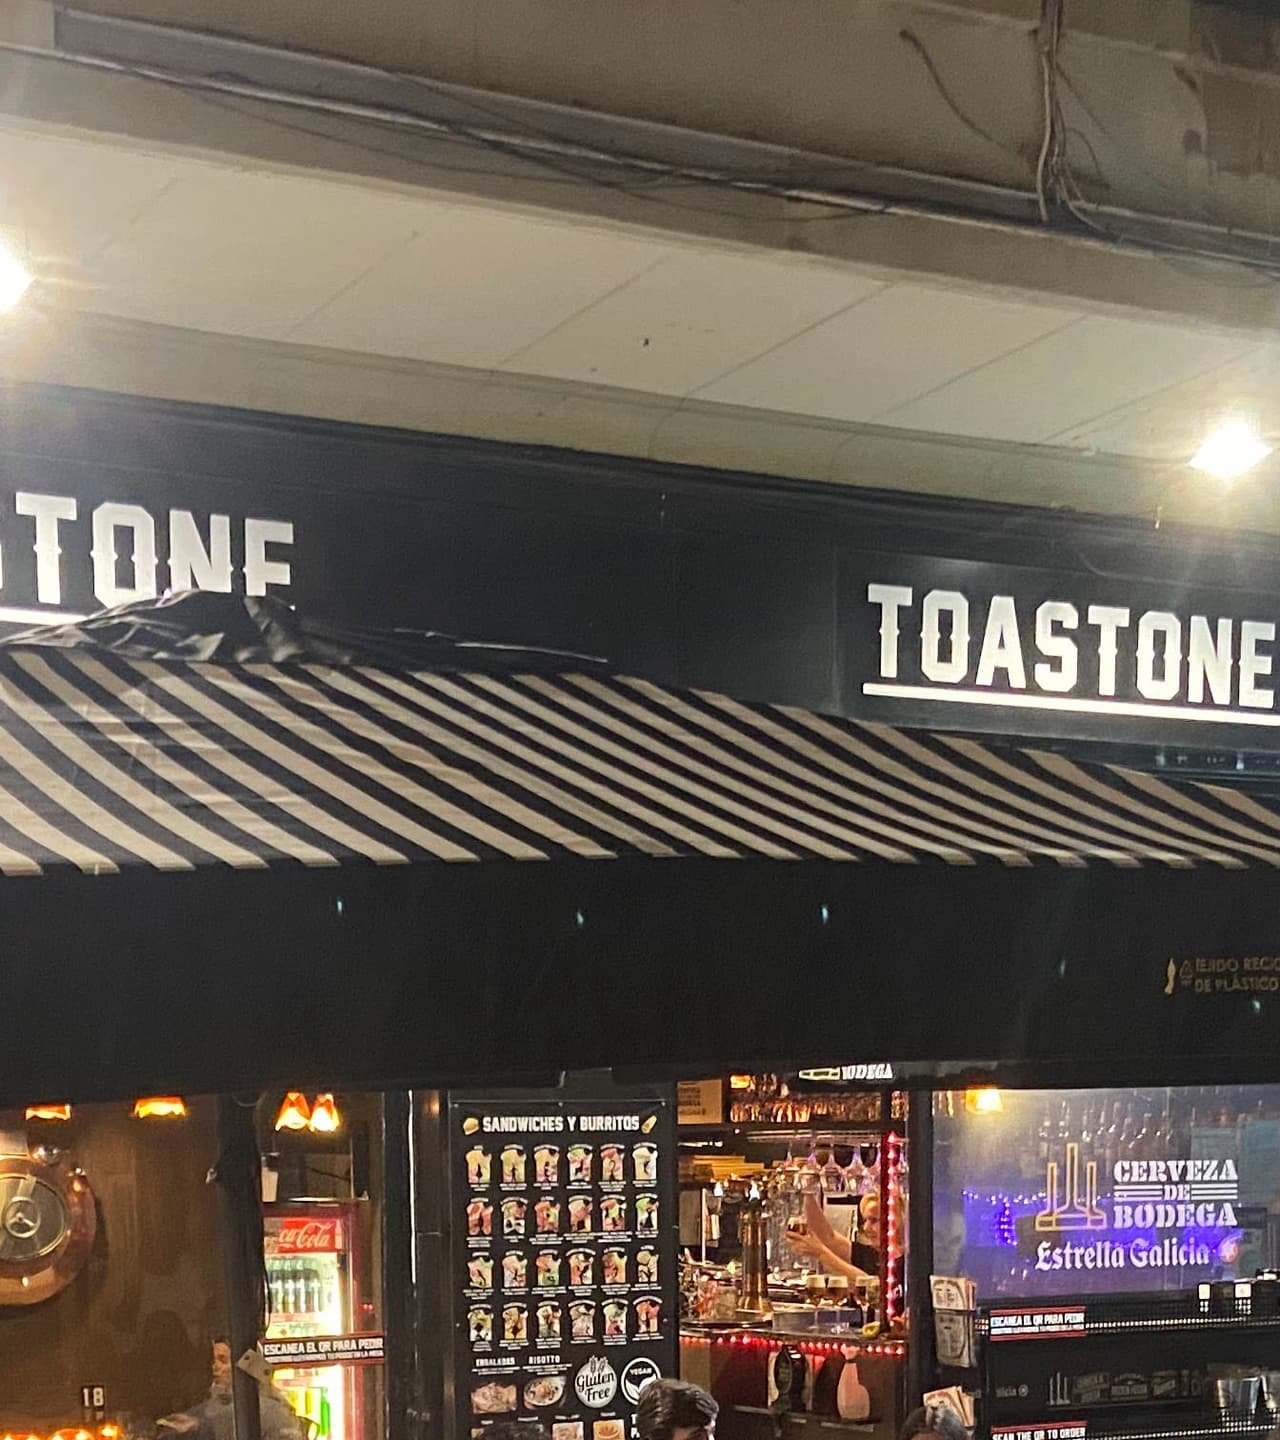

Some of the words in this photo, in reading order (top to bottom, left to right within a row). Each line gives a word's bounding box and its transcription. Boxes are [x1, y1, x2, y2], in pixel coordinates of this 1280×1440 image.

[868, 583, 1276, 709] TOASTONE
[483, 1115, 564, 1133] SANDWICHES
[567, 1115, 578, 1132] Y
[580, 1115, 640, 1131] BURRITOS
[1114, 1159, 1239, 1183] CERVEZA
[1163, 1184, 1191, 1200] DE
[1114, 1203, 1239, 1229] BODEGA
[1035, 1239, 1126, 1271] Estrella
[1130, 1237, 1210, 1268] Galicia
[264, 1342, 305, 1355] ESCANEA
[333, 1339, 357, 1351] PARA
[528, 1355, 560, 1365] RISOTTO
[629, 1367, 652, 1376] VEGAN
[577, 1372, 615, 1393] Gluten
[83, 1387, 104, 1407] 18
[584, 1387, 610, 1402] Free
[1047, 1429, 1059, 1439] TO
[1059, 1427, 1086, 1438] ORDER
